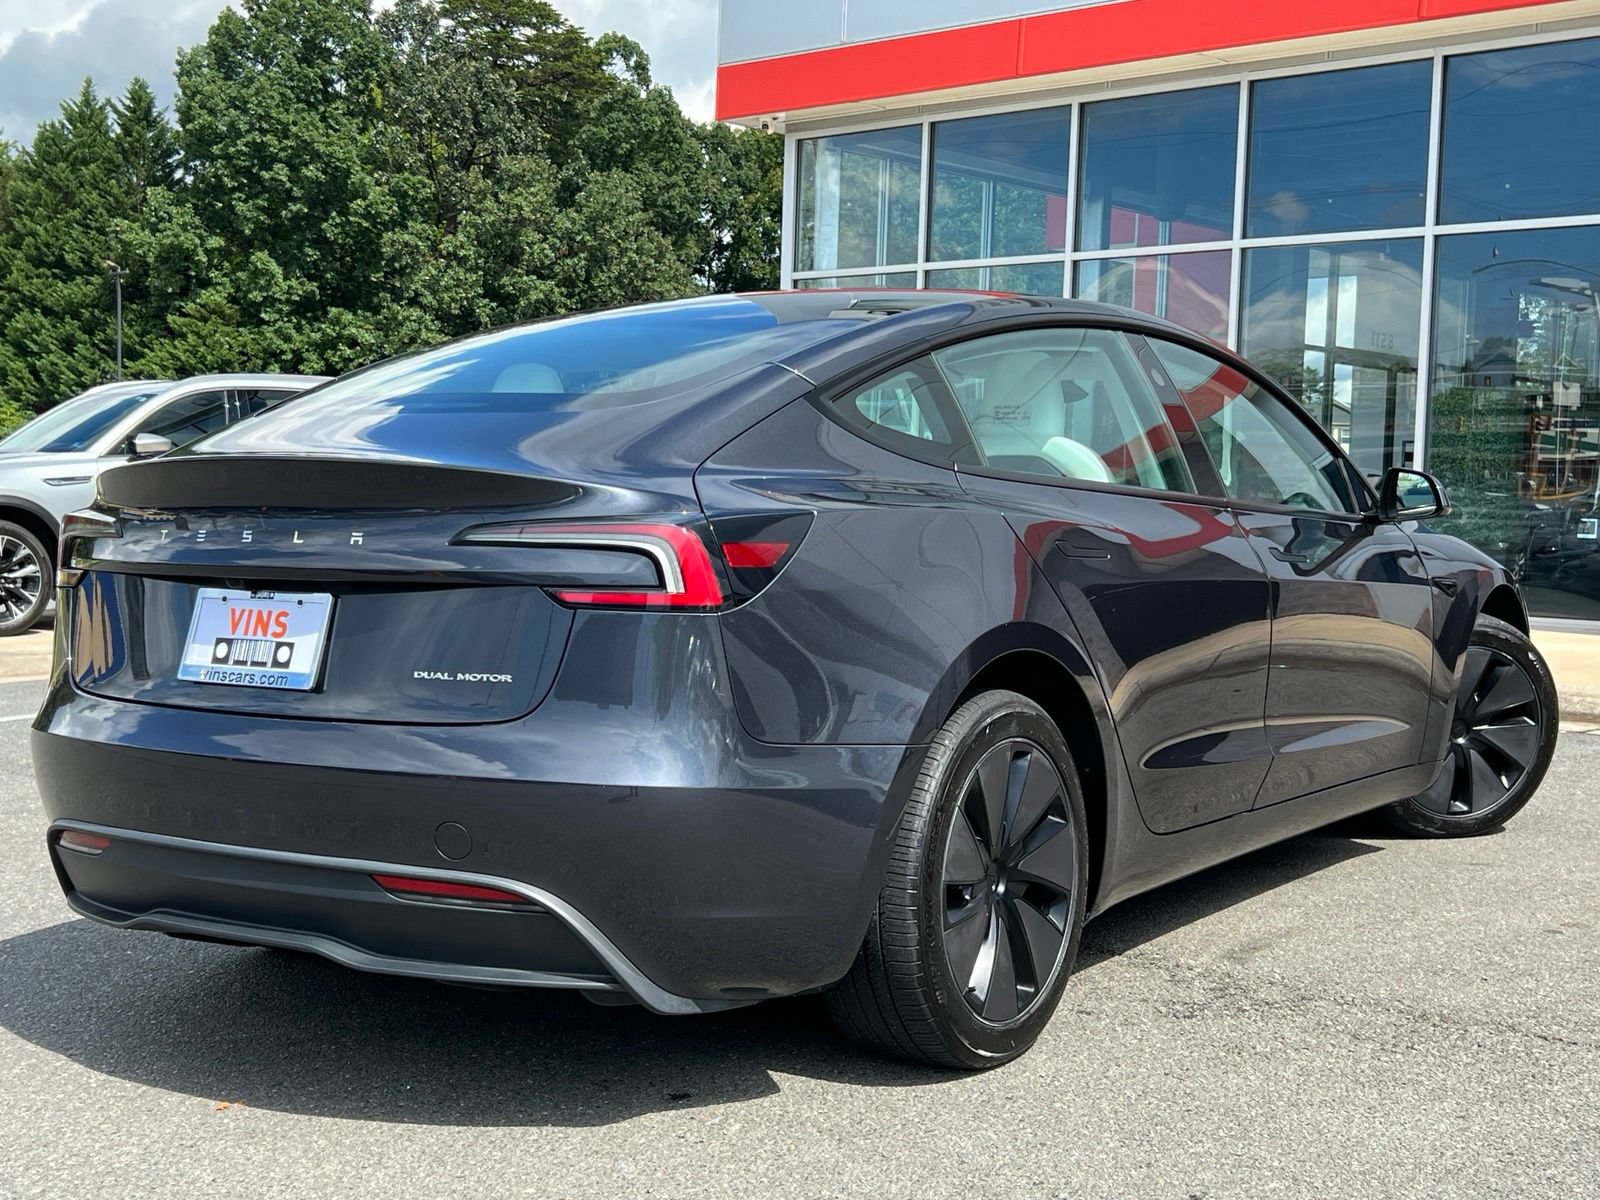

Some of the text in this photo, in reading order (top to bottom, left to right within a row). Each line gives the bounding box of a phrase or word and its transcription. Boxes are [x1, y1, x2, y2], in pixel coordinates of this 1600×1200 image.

[160, 529, 364, 545] TESLA
[230, 607, 290, 639] VINS
[413, 671, 513, 683] DUAL MOTOR
